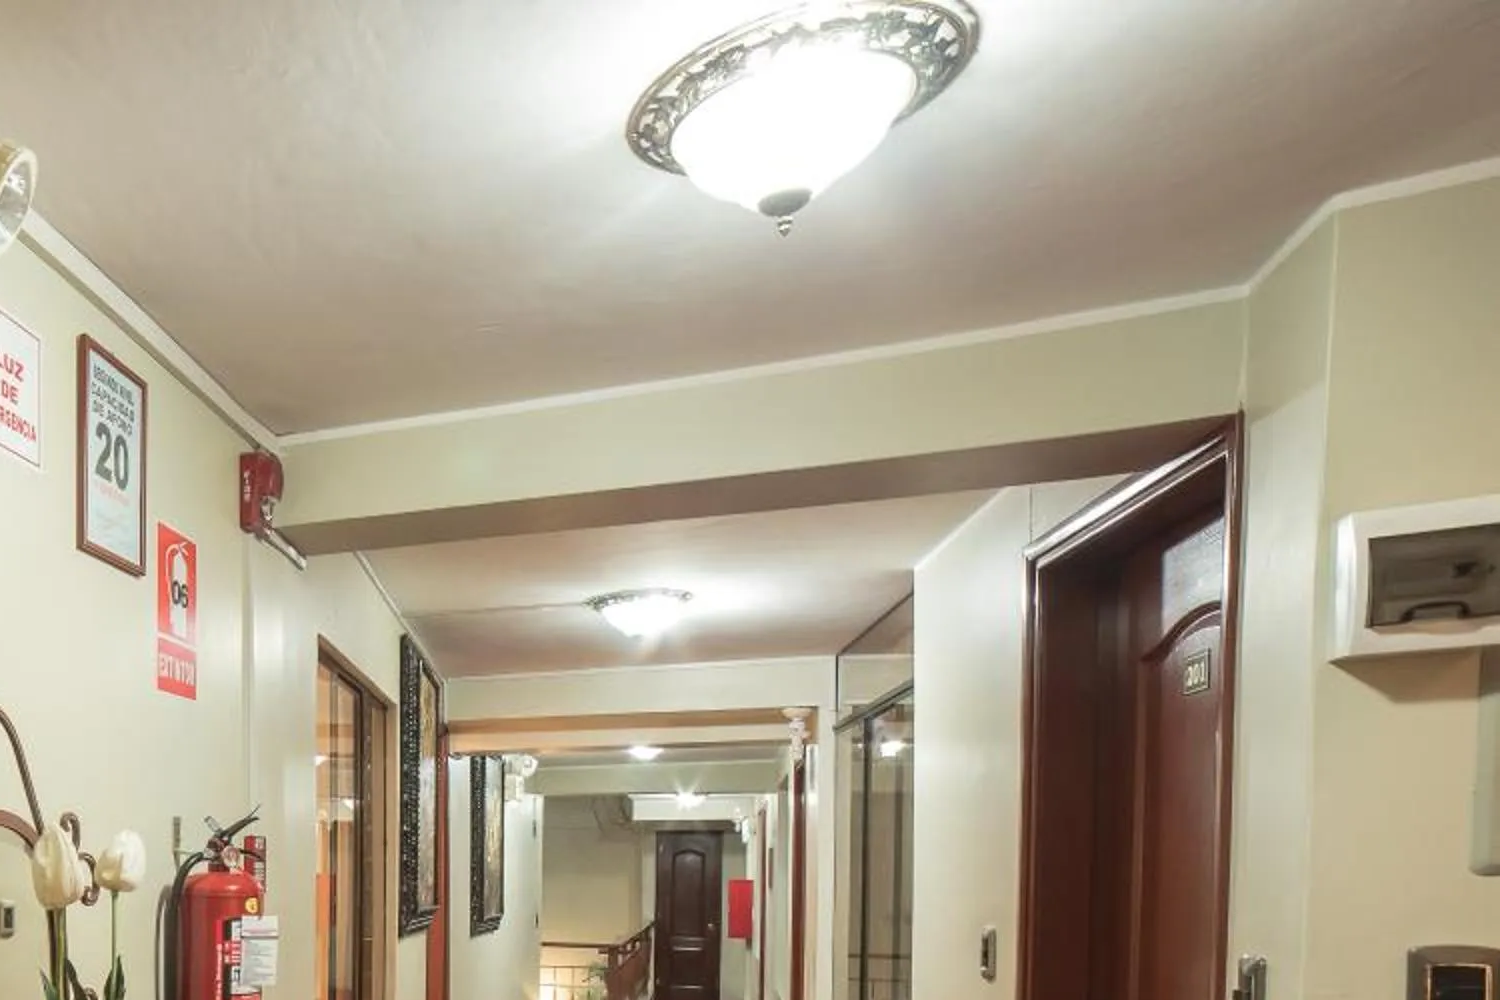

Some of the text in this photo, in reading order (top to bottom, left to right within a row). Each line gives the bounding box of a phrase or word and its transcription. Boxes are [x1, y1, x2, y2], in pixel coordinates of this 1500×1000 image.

[1, 379, 19, 405] DE
[95, 421, 129, 492] 20
[171, 579, 189, 609] 06
